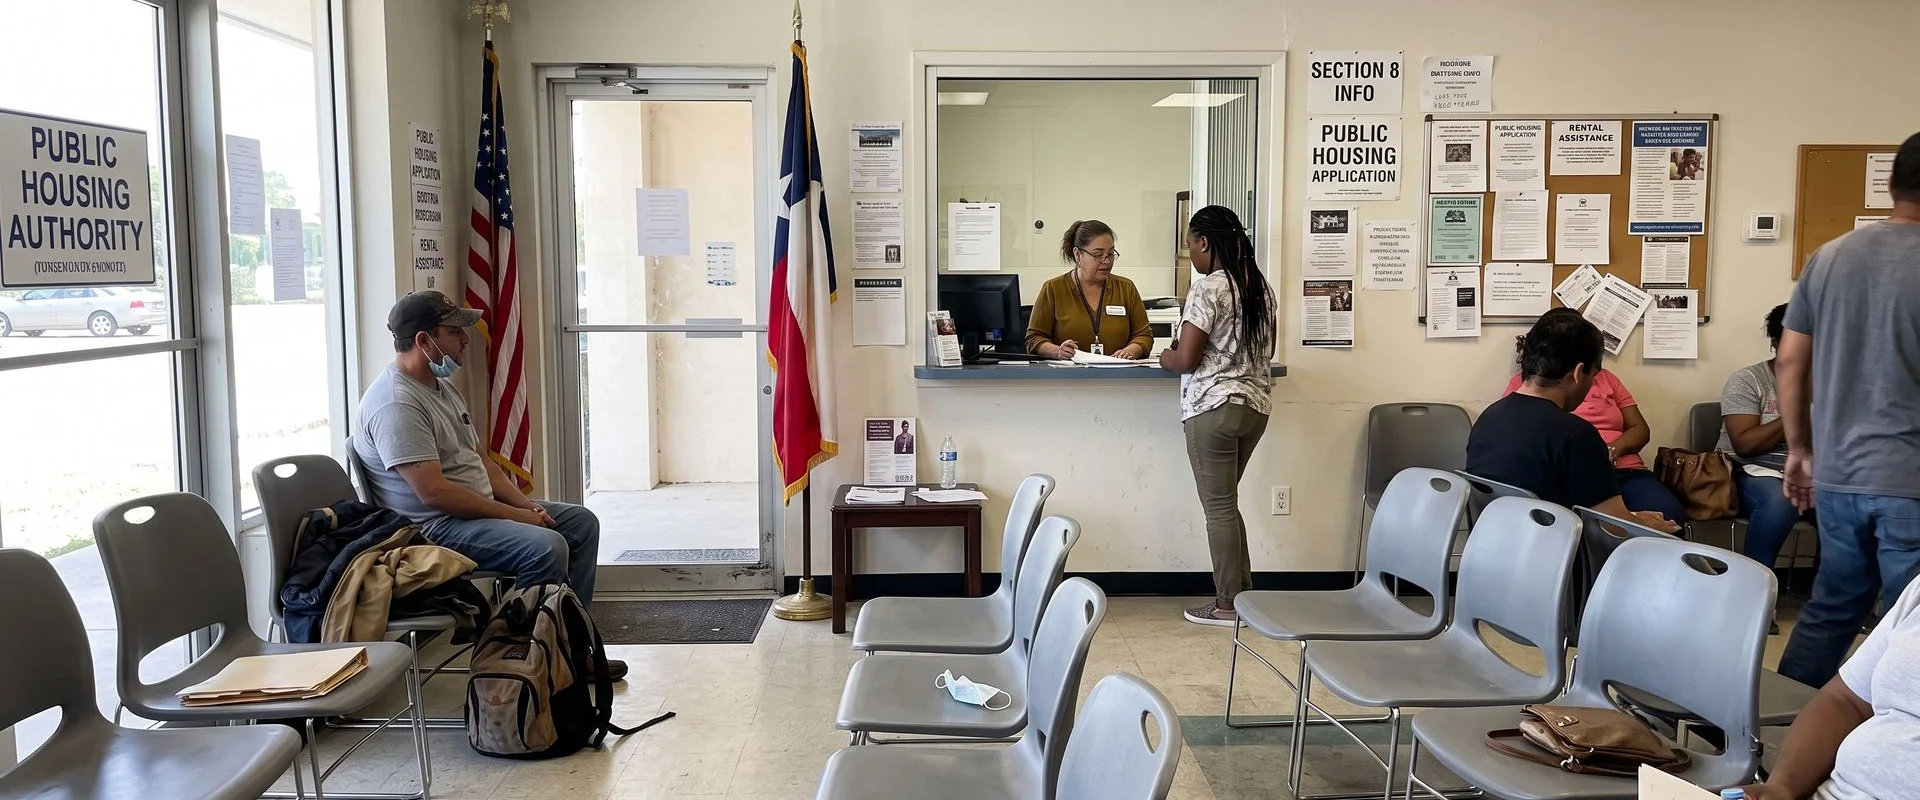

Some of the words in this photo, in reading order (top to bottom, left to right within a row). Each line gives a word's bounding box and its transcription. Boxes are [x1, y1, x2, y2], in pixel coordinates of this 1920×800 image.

[1311, 61, 1384, 79] SECTION
[1389, 61, 1400, 79] 8
[1335, 84, 1375, 102] INFO
[1321, 124, 1388, 143] PUBLIC
[1569, 124, 1604, 132] RENTAL
[416, 129, 434, 145] PUBLIC
[1558, 134, 1614, 142] ASSISTANCE
[31, 126, 118, 169] PUBLIC
[414, 147, 438, 164] HOUSING
[1312, 146, 1396, 165] HOUSING
[412, 164, 441, 181] APPLICATION
[1312, 169, 1396, 183] APPLICATION
[21, 169, 131, 211] HOUSING
[8, 214, 144, 252] AUTHORITY
[420, 238, 439, 252] RENTAL
[415, 257, 444, 271] ASSISTANCE
